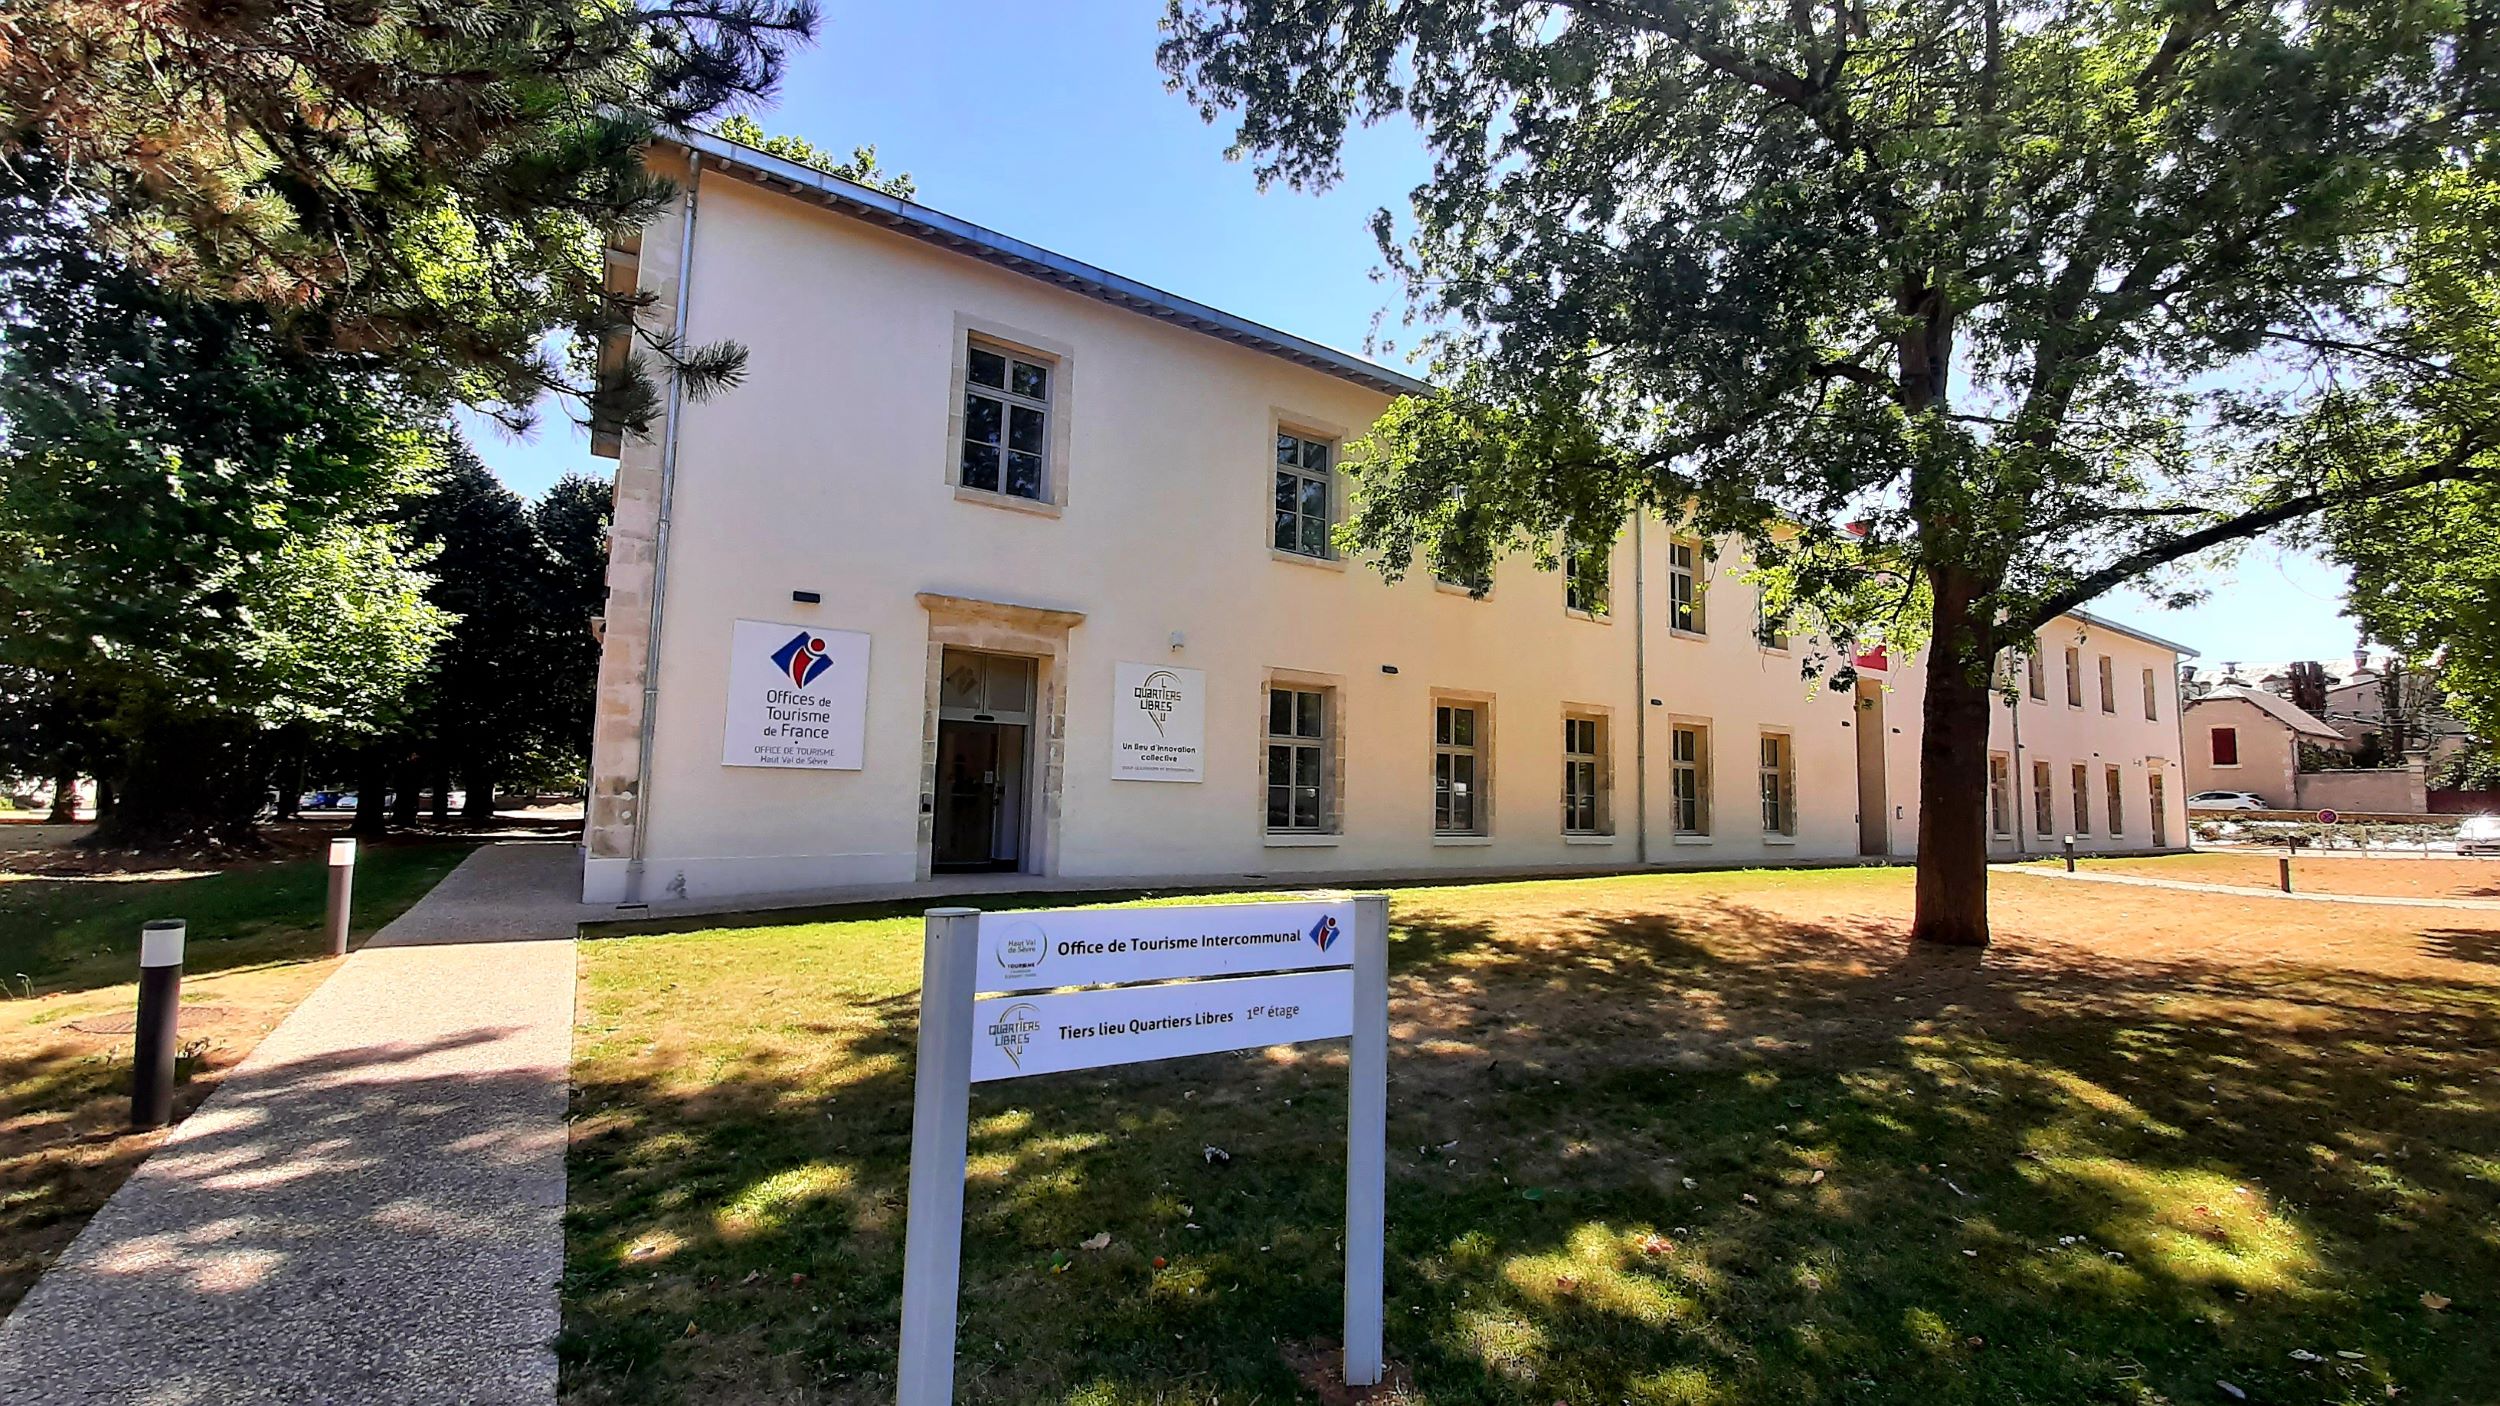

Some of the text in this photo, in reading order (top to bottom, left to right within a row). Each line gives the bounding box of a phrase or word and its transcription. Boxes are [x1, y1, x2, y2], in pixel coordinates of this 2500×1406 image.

[766, 689, 832, 707] Offices de
[1134, 687, 1182, 701] QUARTIERS
[1140, 699, 1172, 712] LIBRES
[766, 706, 830, 723] Tourisme
[763, 723, 830, 739] de France
[754, 745, 835, 756] OFFICE DE TOURISME
[1122, 742, 1196, 754] Un lieu d'innovation
[760, 755, 779, 764] Haut
[782, 755, 794, 764] Val
[795, 756, 805, 765] de
[1140, 754, 1178, 762] collective
[1057, 929, 1301, 956] Office de Tourisme Intercommunal
[988, 1021, 1040, 1036] QUARTIERS
[1058, 1024, 1095, 1040] Tiers
[1099, 1021, 1125, 1036] lieu
[1129, 1014, 1192, 1034] Quartiers
[1195, 1010, 1233, 1026] Libres
[1267, 1004, 1300, 1019] étage
[995, 1033, 1030, 1047] LIBRES
